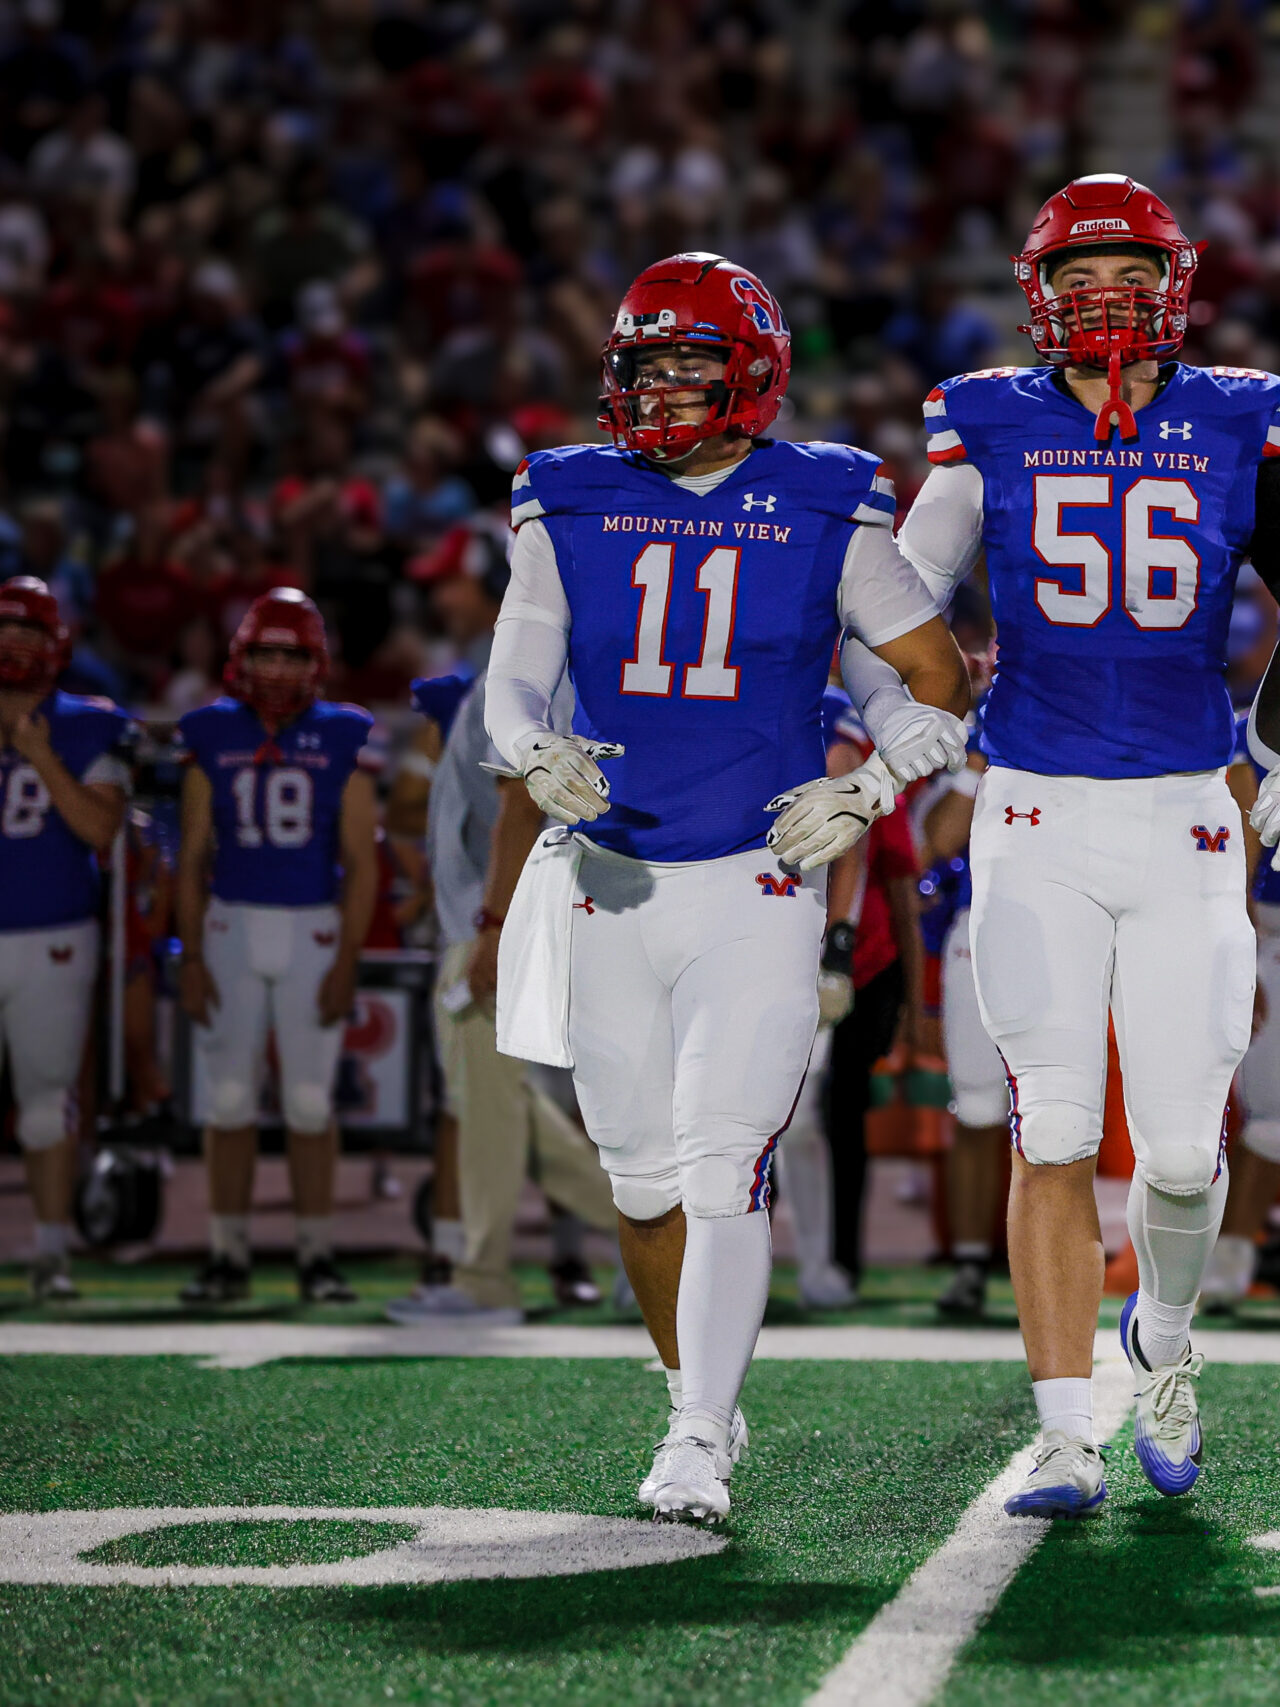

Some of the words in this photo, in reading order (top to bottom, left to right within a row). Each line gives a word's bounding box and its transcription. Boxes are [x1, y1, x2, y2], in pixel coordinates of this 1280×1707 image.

[1076, 220, 1122, 232] Riddell
[1023, 449, 1143, 468] MOUNTAIN
[1153, 452, 1210, 473] VIEW
[602, 515, 724, 538] MOUNTAIN
[732, 522, 792, 544] VIEW
[1030, 473, 1201, 632] 56
[619, 540, 743, 702] 11
[0, 763, 53, 840] 8
[232, 765, 314, 849] 18
